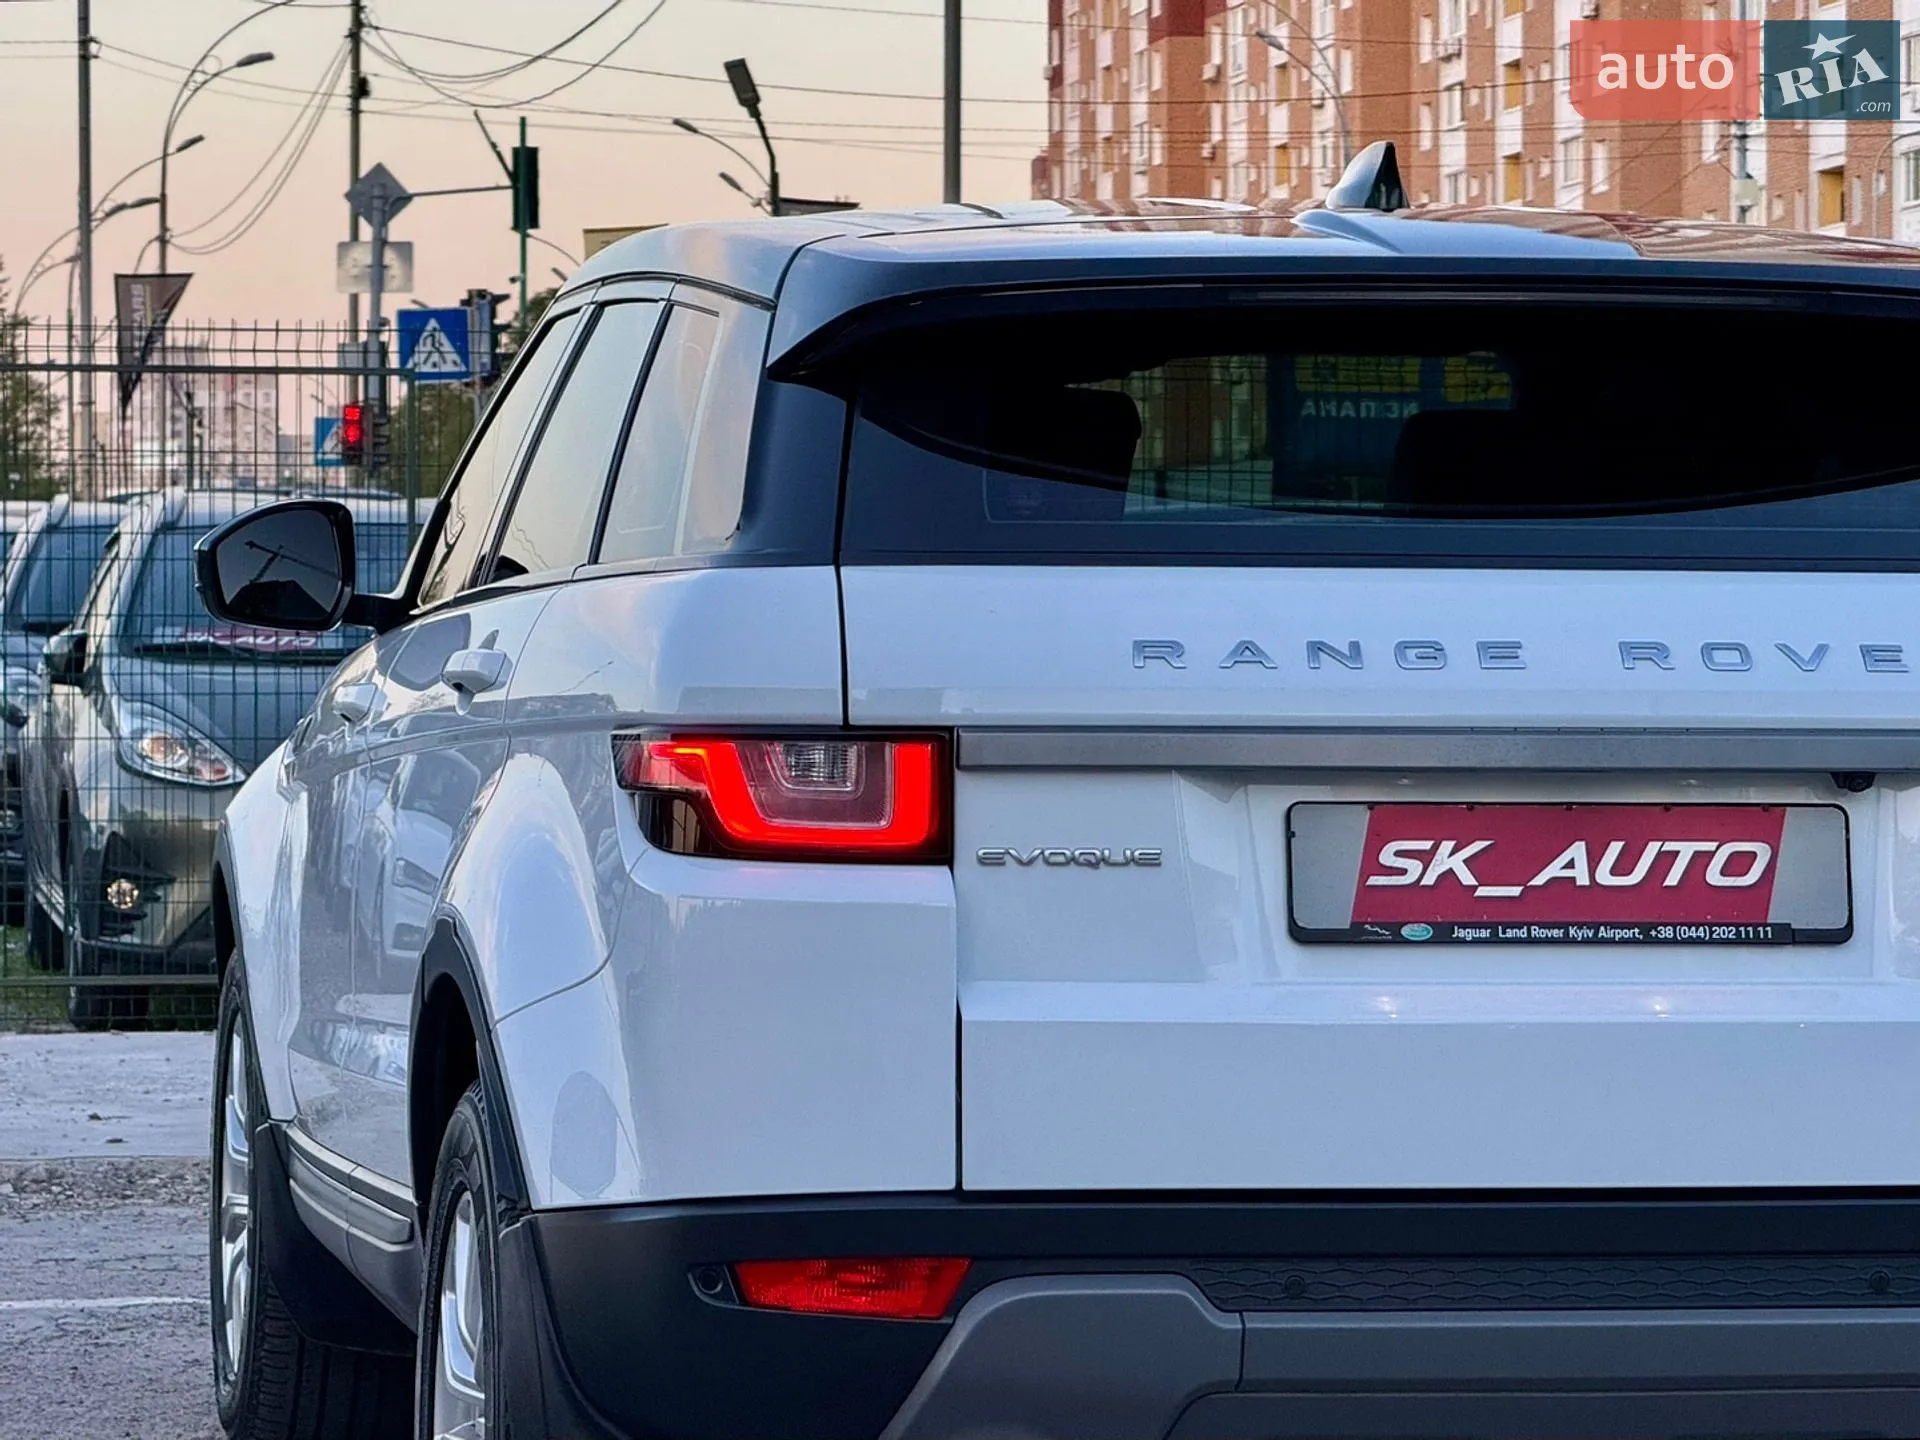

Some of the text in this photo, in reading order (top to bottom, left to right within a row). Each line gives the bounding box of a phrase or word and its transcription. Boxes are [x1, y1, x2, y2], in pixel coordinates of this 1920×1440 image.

[1130, 637, 1913, 673] RANGE ROVE
[976, 846, 1163, 870] EVOQUE
[1364, 839, 1774, 898] SK_AUTO
[1451, 925, 1492, 941] Jaguar
[1498, 925, 1528, 938] Land
[1531, 925, 1565, 938] Rover
[1568, 925, 1595, 941] Kyiv
[1598, 925, 1644, 941] Airport,
[1649, 926, 1674, 939] +38
[1676, 925, 1710, 941] (044)
[1711, 926, 1737, 939] 202
